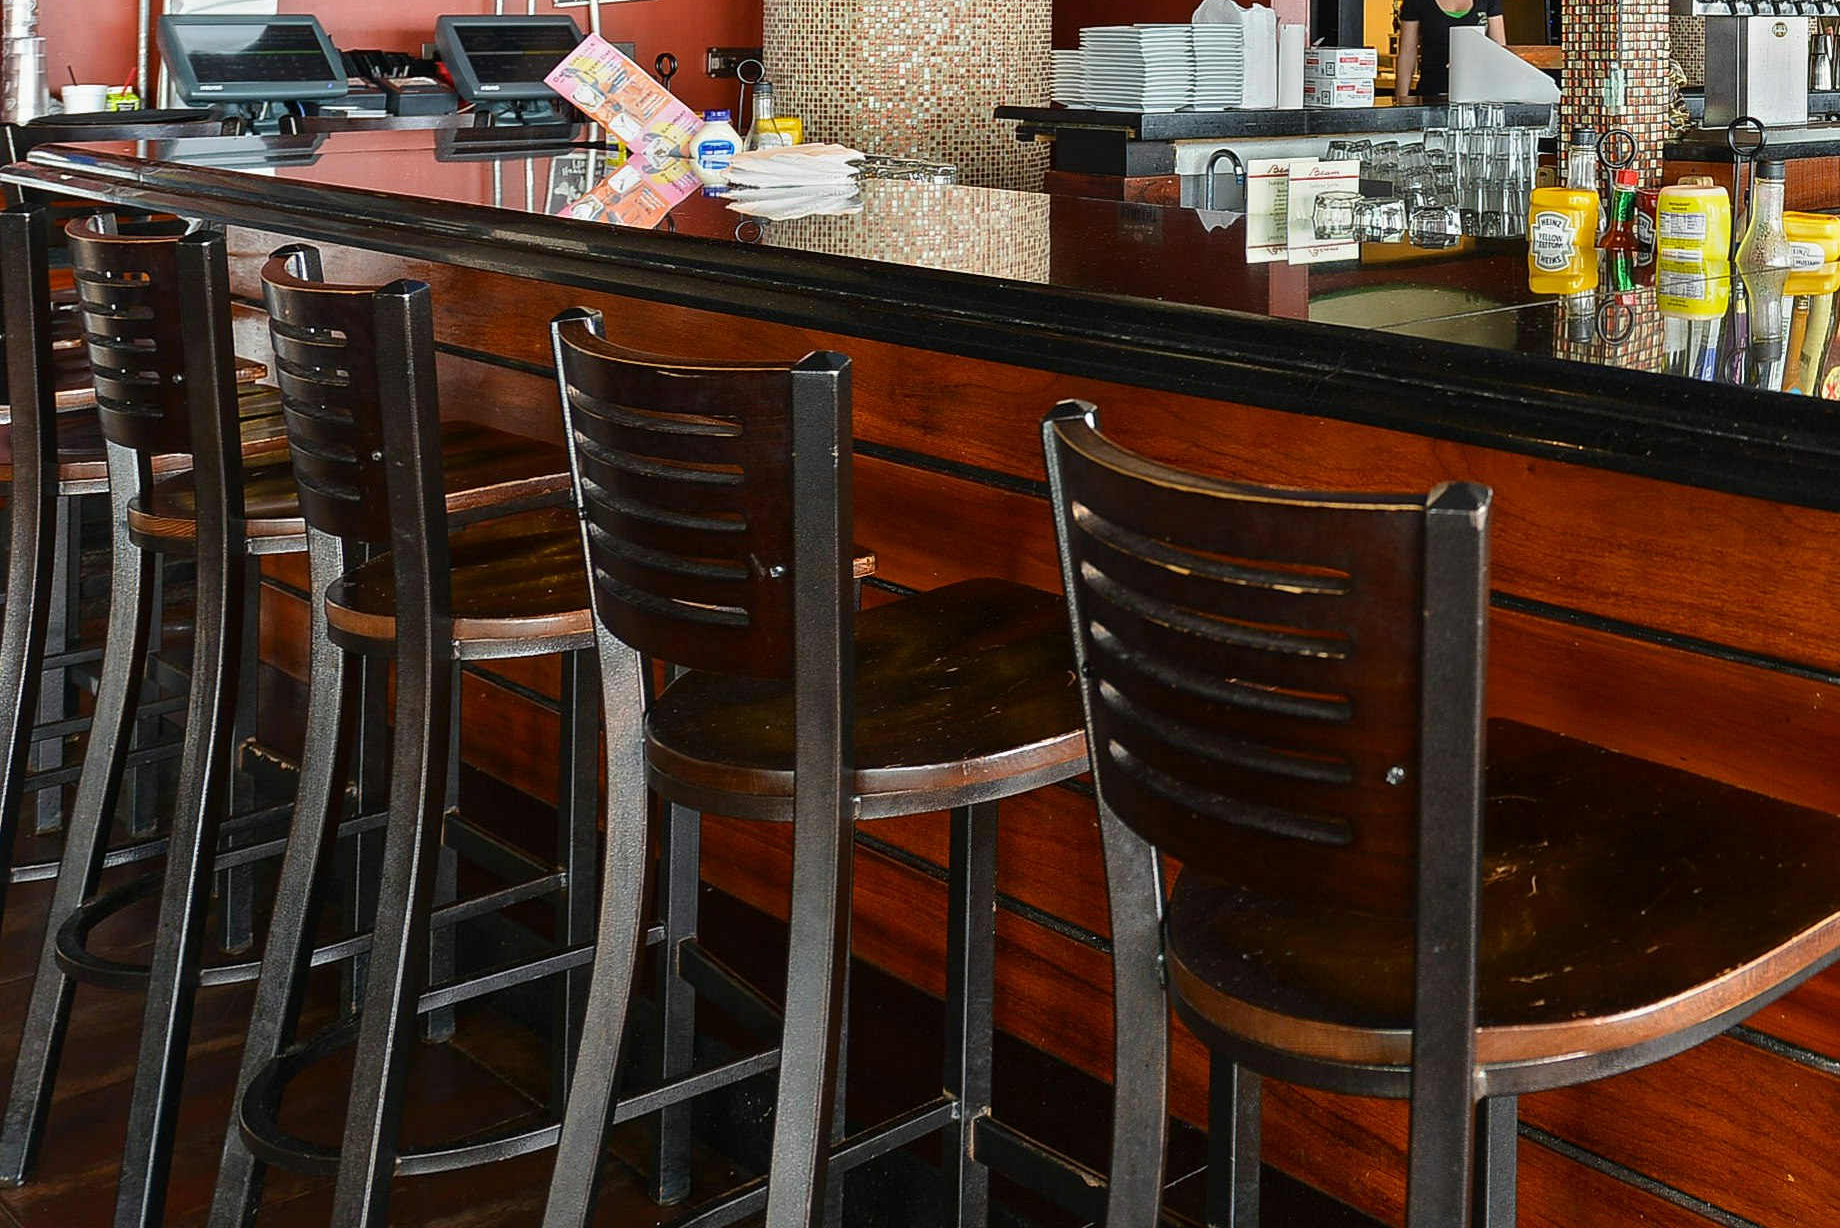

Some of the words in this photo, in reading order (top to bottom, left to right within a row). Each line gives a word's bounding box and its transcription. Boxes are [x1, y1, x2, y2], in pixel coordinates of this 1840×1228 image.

[1308, 166, 1341, 177] Beam
[1540, 218, 1562, 228] HEINZ
[1538, 233, 1563, 243] YELLOW
